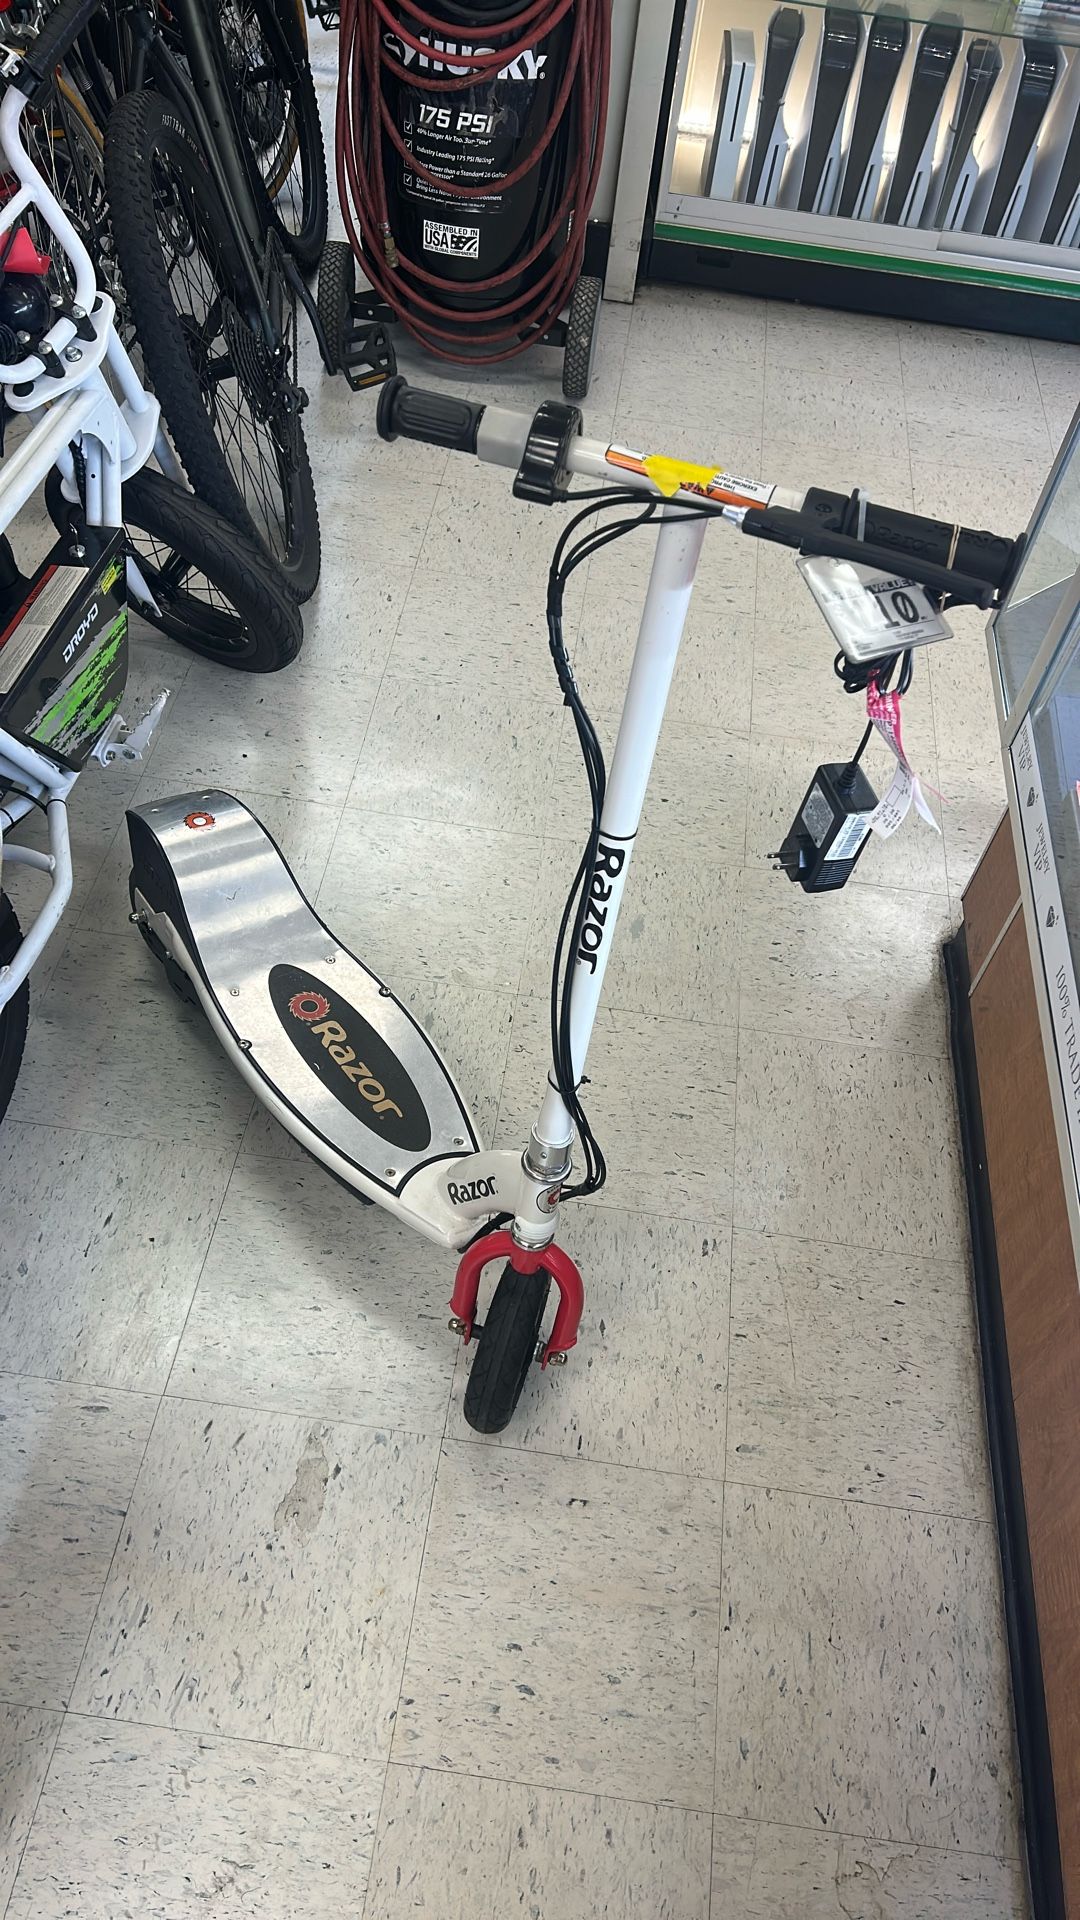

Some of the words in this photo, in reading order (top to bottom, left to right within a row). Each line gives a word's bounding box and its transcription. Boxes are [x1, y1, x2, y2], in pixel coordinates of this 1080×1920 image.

[420, 104, 451, 128] 175
[456, 112, 494, 133] PSI
[427, 130, 444, 140] Longer
[416, 145, 435, 157] Industry
[436, 150, 455, 161] Leading
[456, 154, 466, 162] 175
[429, 164, 443, 172] Power
[444, 166, 456, 175] than
[460, 170, 484, 178] Standard
[425, 222, 468, 236] ASSEMBLED
[425, 228, 449, 248] USA
[62, 602, 99, 664] DROYD
[1018, 745, 1027, 770] VIP
[1034, 843, 1043, 872] VIP
[1036, 822, 1050, 874] JEWELRY
[578, 842, 625, 974] Razor
[1056, 965, 1070, 1018] 100%
[310, 1020, 403, 1118] Razor
[448, 1175, 496, 1205] Razor
